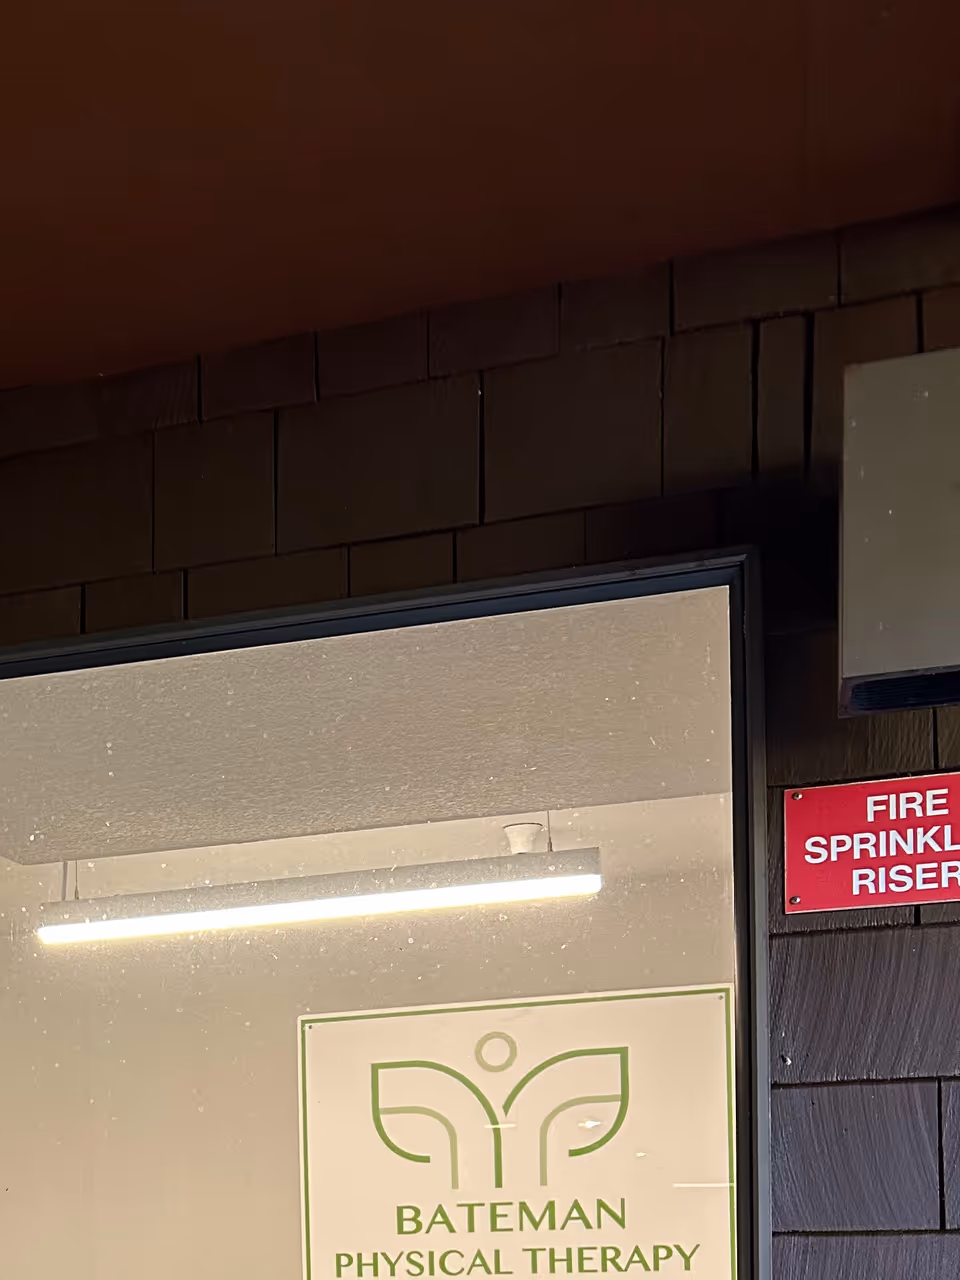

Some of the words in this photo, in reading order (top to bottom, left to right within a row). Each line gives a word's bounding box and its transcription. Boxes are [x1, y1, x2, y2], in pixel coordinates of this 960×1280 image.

[866, 788, 949, 823] FIRE
[803, 824, 960, 864] SPRINKL
[851, 860, 960, 896] RISER
[395, 1197, 628, 1236] BATEMAN
[335, 1248, 513, 1279] PHYSICAL
[522, 1243, 701, 1275] THERAPY
